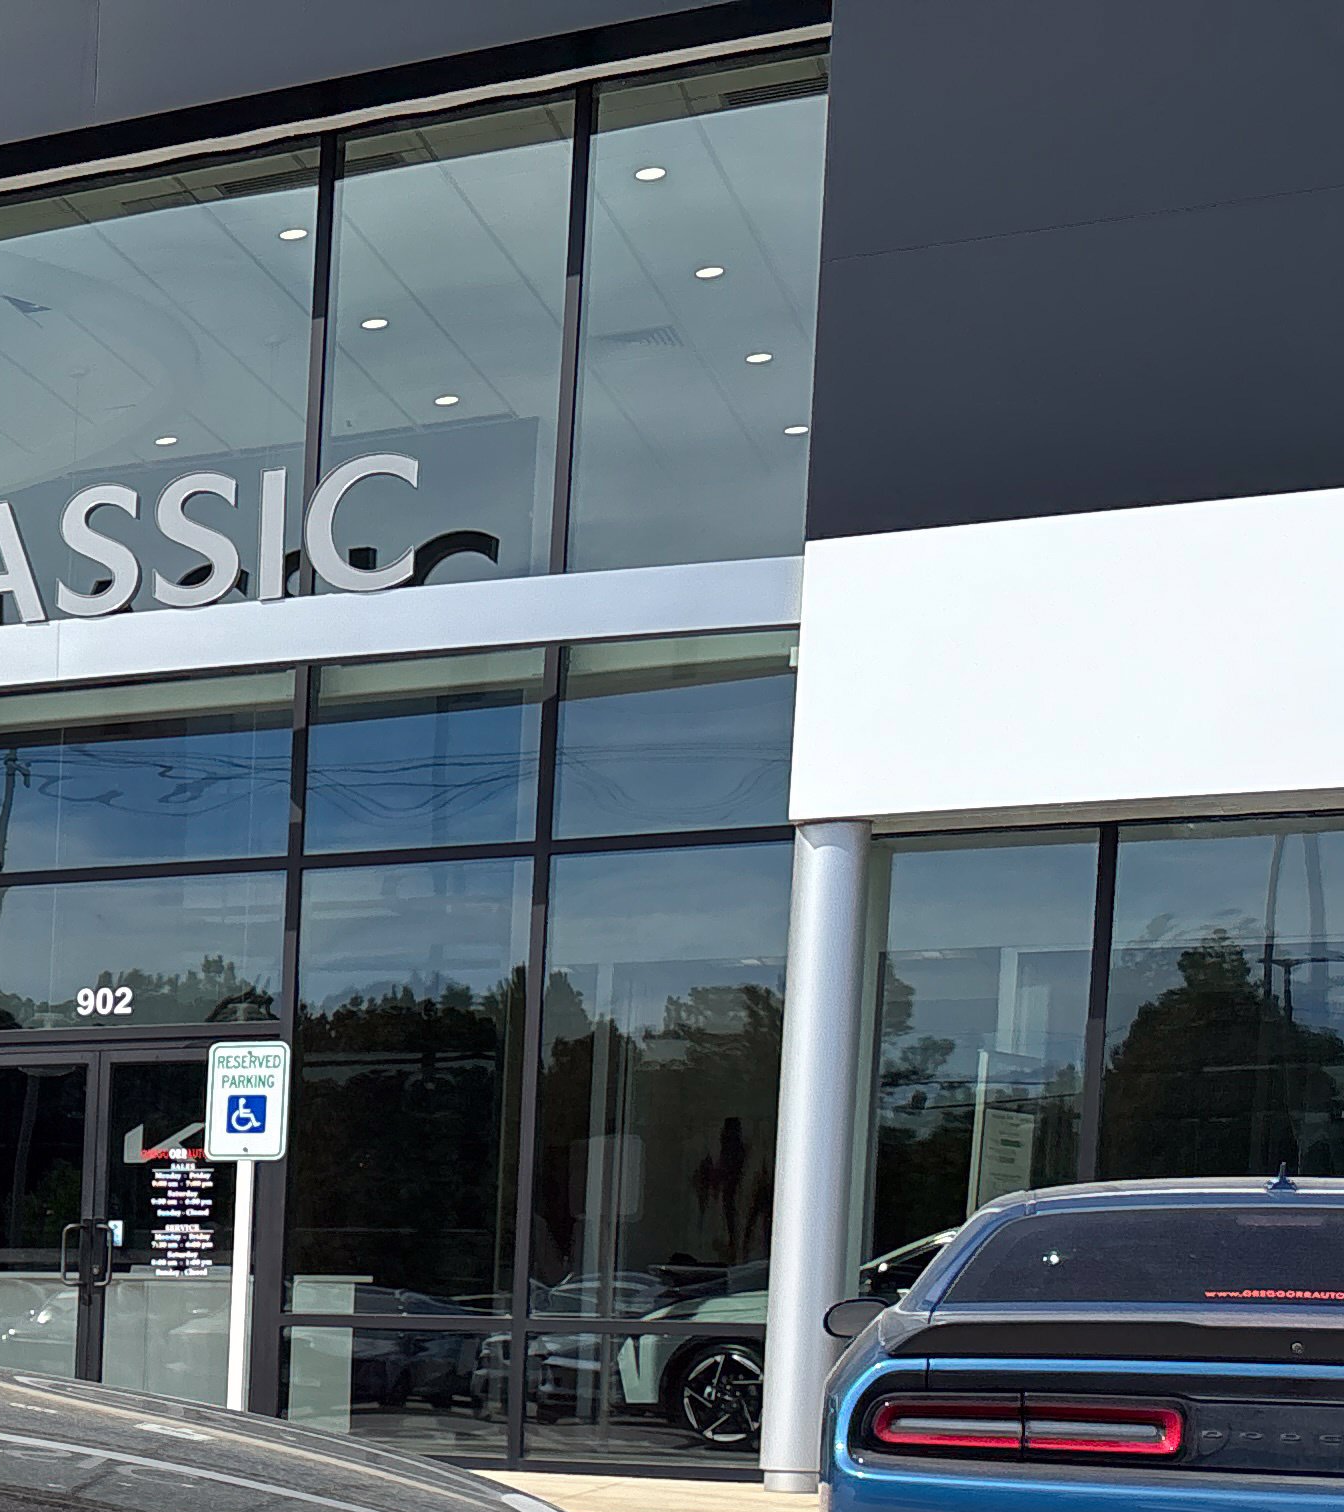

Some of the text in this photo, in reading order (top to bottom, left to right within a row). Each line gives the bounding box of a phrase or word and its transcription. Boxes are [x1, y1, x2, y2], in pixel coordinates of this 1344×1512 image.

[76, 986, 133, 1016] 902
[217, 1054, 281, 1069] RESERVED
[221, 1074, 275, 1089] PARKING
